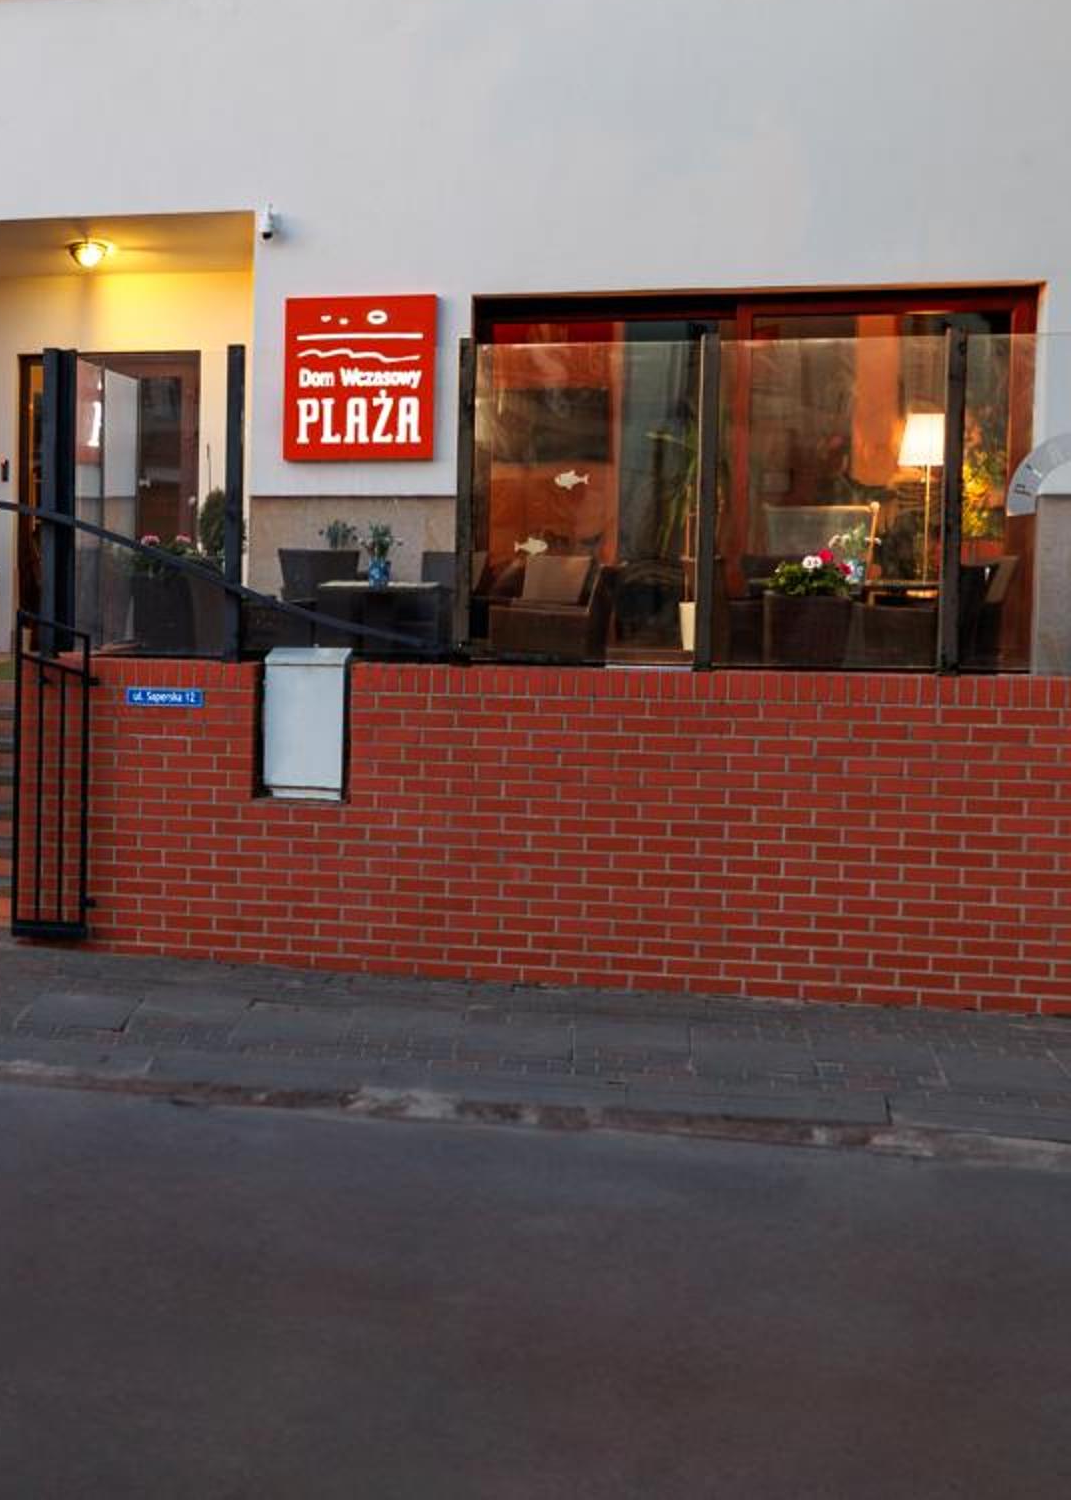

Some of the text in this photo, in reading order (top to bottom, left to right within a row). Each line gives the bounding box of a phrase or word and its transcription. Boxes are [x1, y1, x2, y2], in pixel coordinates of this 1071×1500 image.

[298, 367, 422, 389] Dom Wczasowy
[296, 389, 421, 444] PLAŻA
